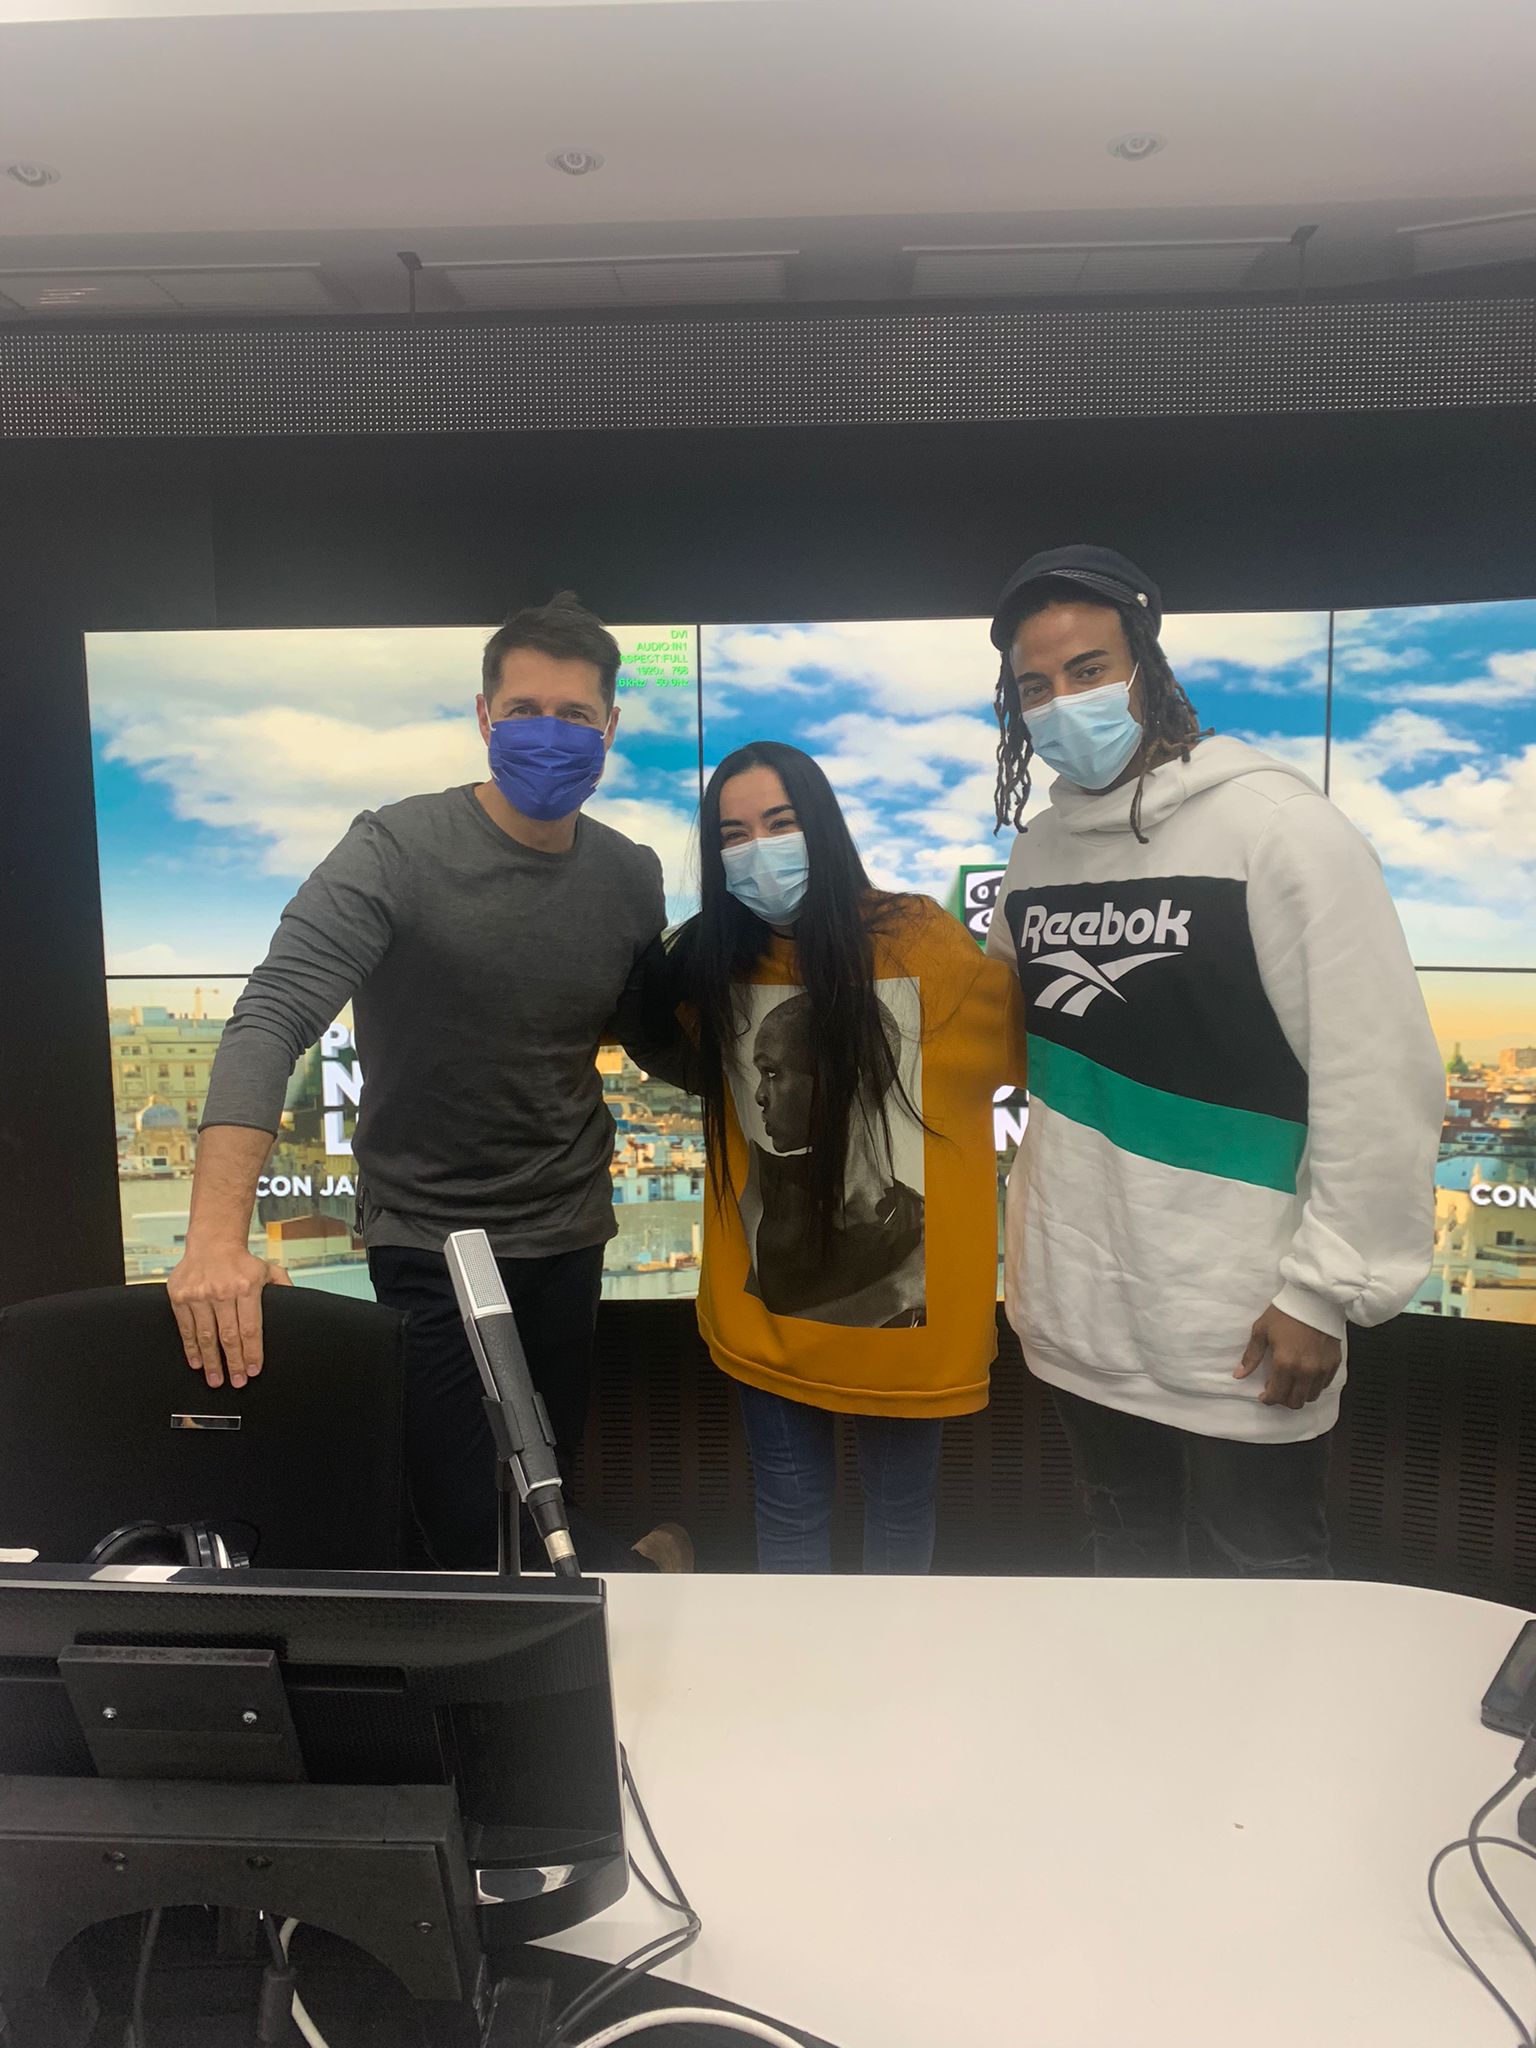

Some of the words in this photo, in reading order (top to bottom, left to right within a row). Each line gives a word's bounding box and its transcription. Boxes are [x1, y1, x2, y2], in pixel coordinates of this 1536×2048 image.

[671, 630, 688, 639] DVI
[1020, 899, 1192, 954] Reebok
[320, 1023, 356, 1058] P
[256, 1175, 312, 1197] CON
[320, 1175, 359, 1196] JA
[1470, 1183, 1536, 1209] CON
